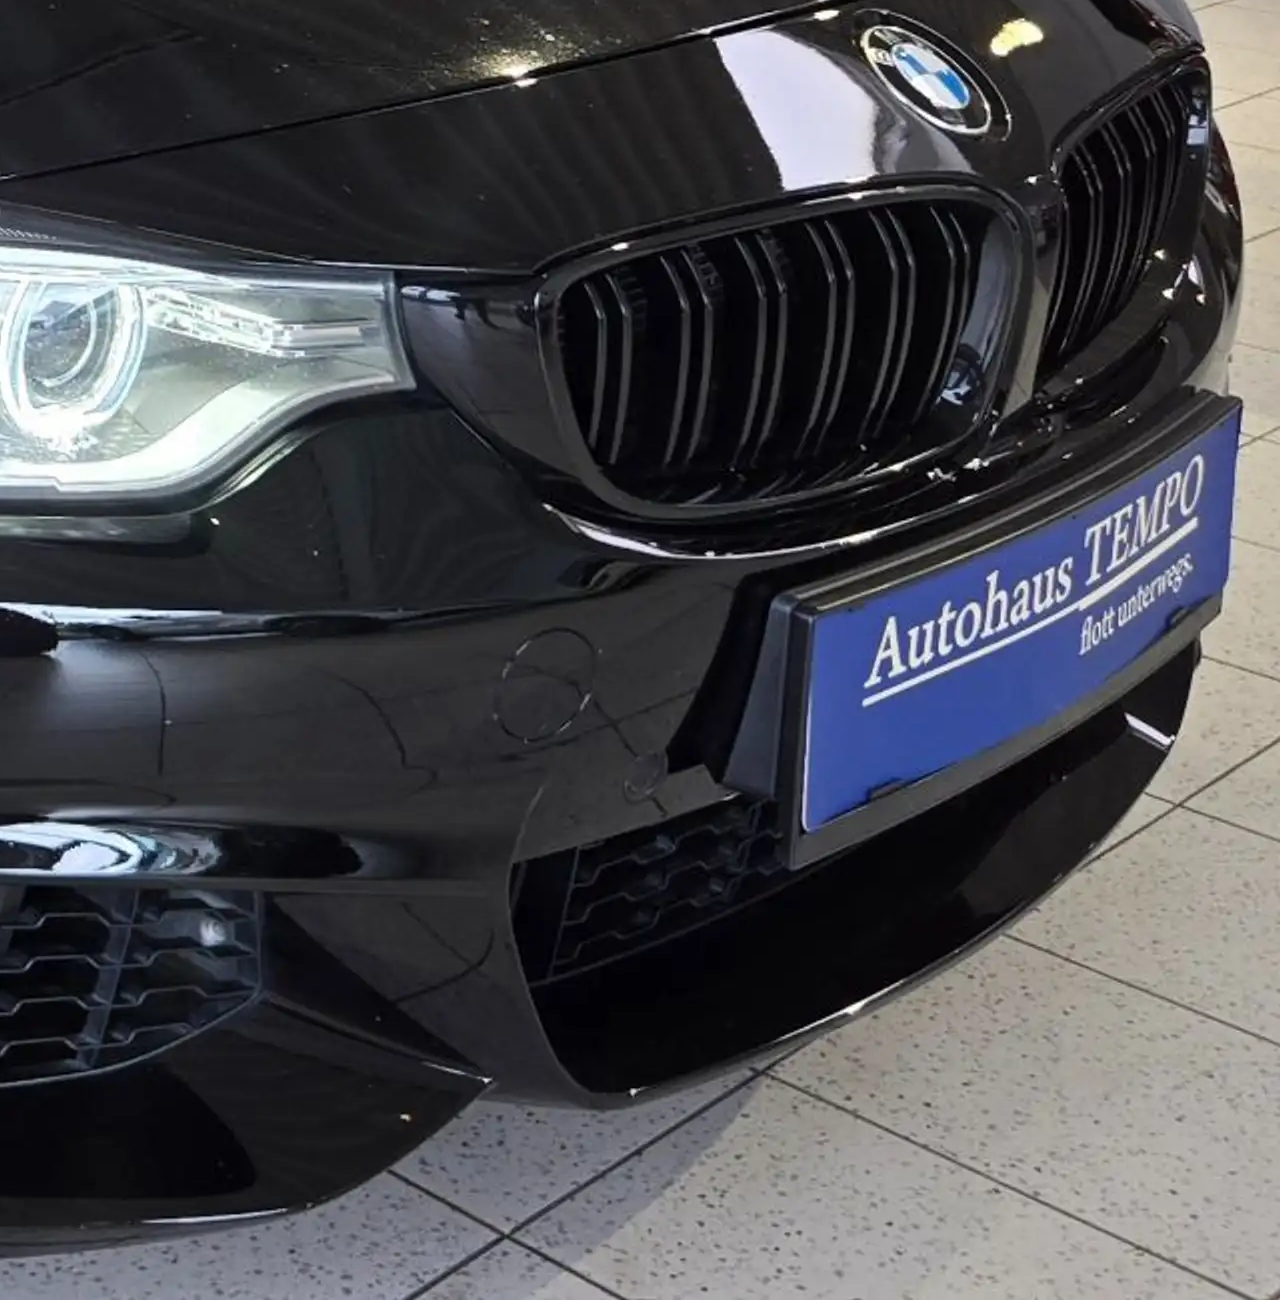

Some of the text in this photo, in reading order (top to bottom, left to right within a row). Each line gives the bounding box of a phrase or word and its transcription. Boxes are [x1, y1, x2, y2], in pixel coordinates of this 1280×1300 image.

[863, 453, 1206, 689] Autohaus TEMPO
[1078, 552, 1195, 657] flott unterwegs.
